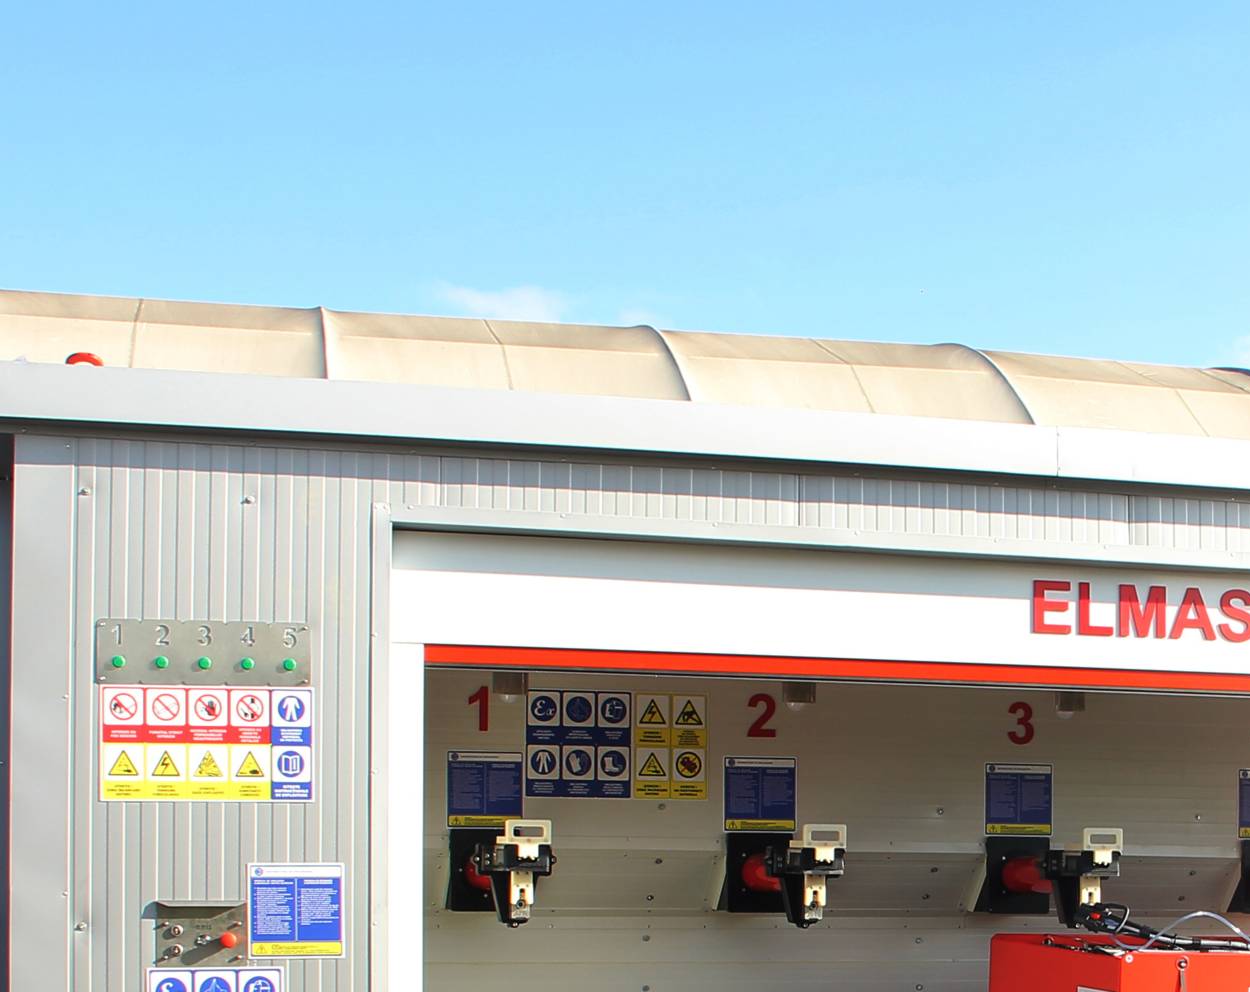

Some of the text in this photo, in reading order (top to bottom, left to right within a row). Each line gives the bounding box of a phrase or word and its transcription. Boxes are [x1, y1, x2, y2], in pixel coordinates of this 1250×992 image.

[111, 623, 297, 648] 1 2 3 4 5
[467, 686, 490, 732] 1
[746, 693, 777, 738] 2
[1007, 701, 1036, 746] 3
